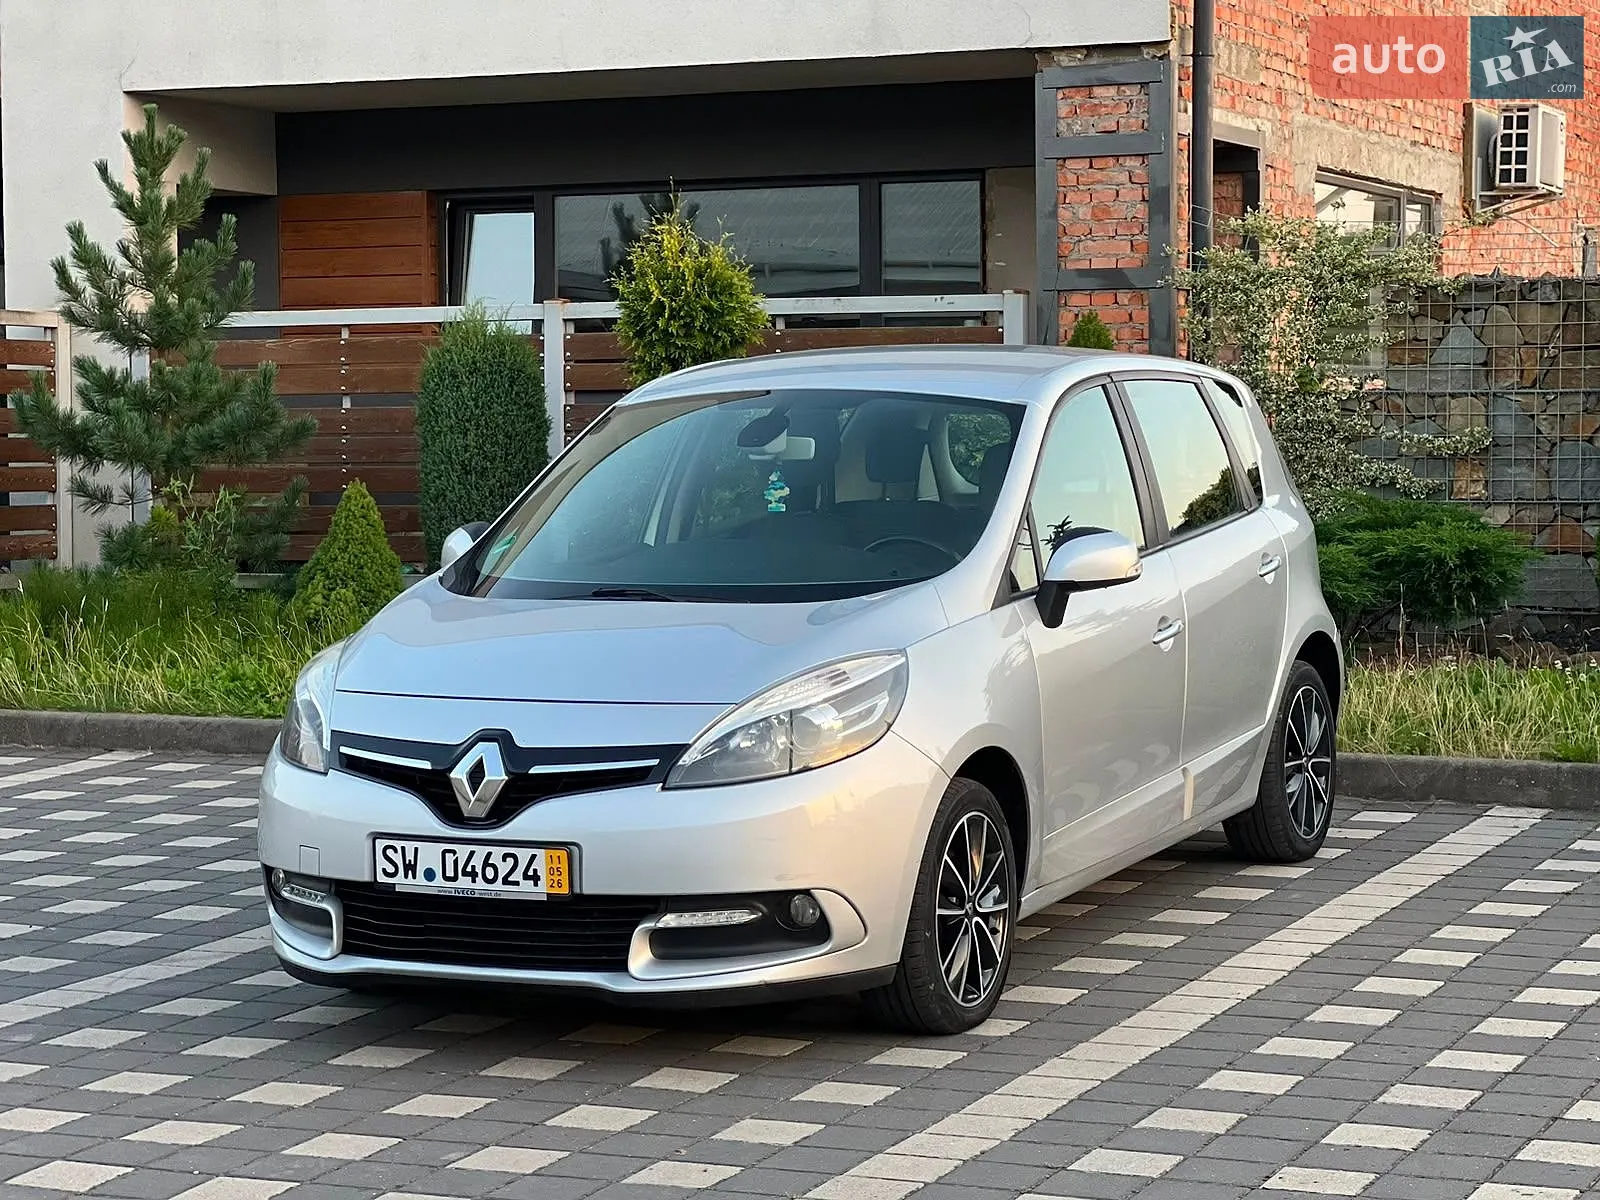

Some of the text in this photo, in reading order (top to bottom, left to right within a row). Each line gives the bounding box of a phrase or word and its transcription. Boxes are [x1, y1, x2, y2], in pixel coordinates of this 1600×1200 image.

[549, 854, 561, 865] 11
[381, 844, 541, 887] SW 04624
[549, 866, 563, 877] 05
[549, 878, 563, 889] 26
